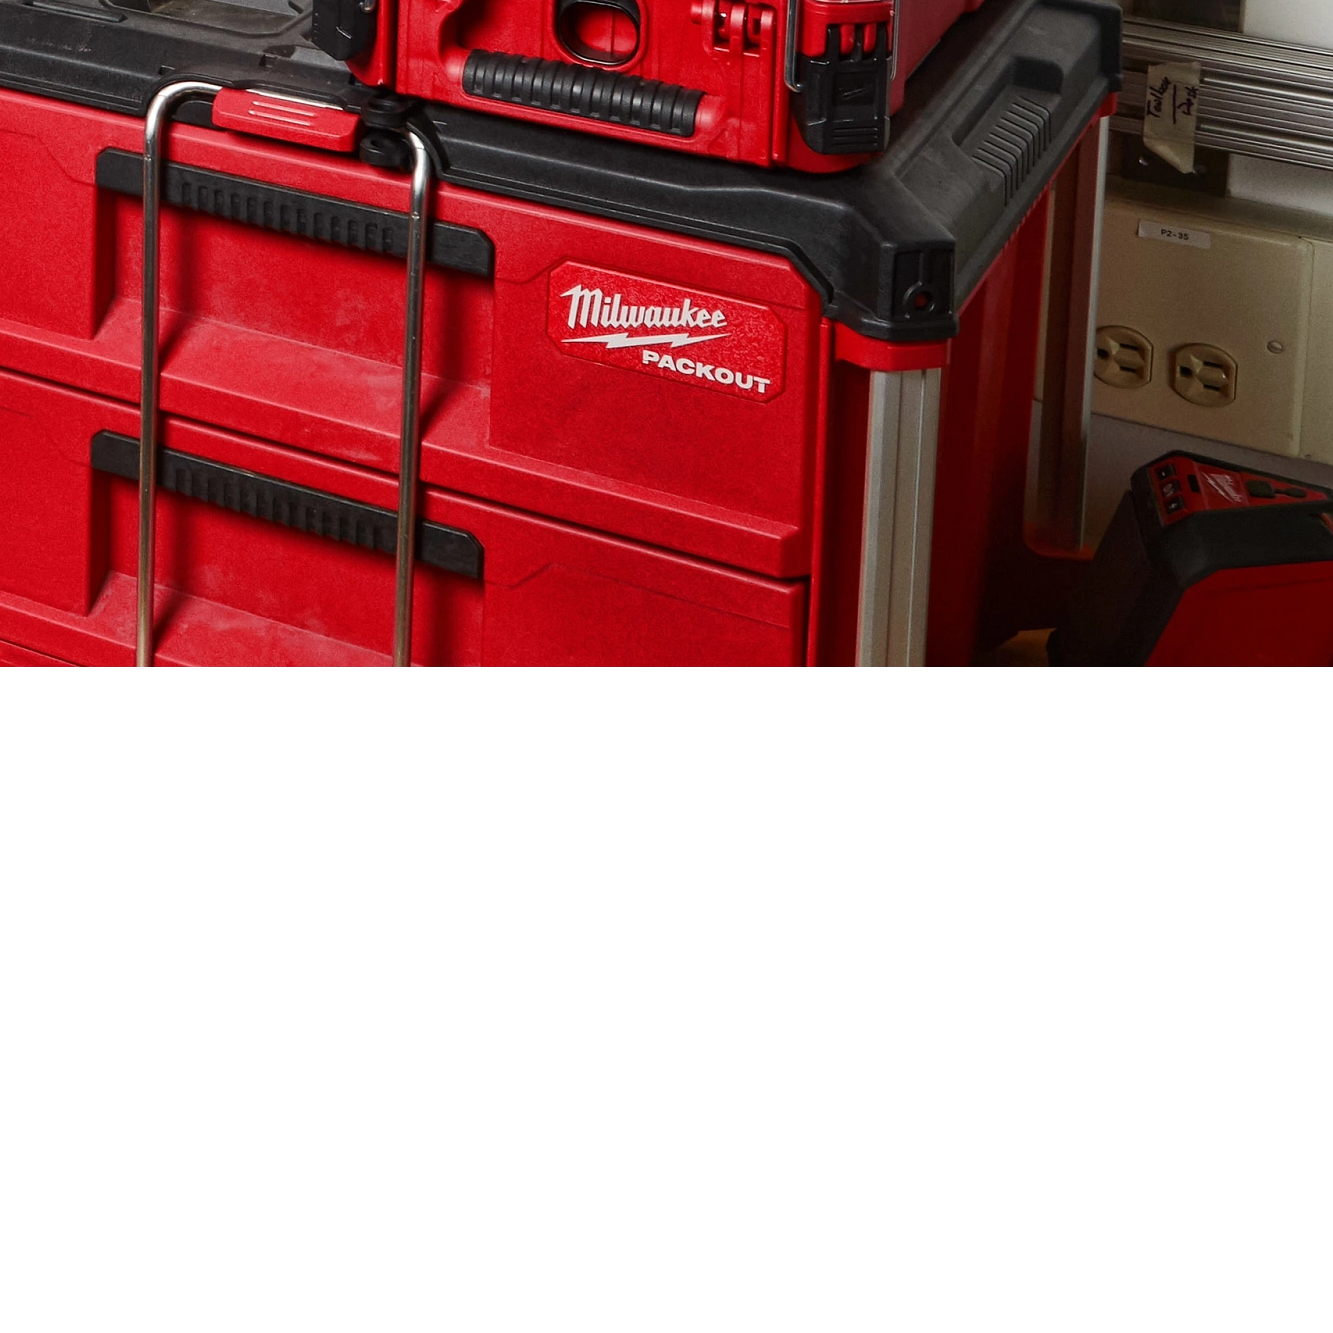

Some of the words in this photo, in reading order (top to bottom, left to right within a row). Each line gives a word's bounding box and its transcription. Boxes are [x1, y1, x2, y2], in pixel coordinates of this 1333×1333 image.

[1160, 228, 1190, 241] P2-35
[560, 284, 728, 330] Milwaukee
[642, 349, 771, 394] PACKOUT
